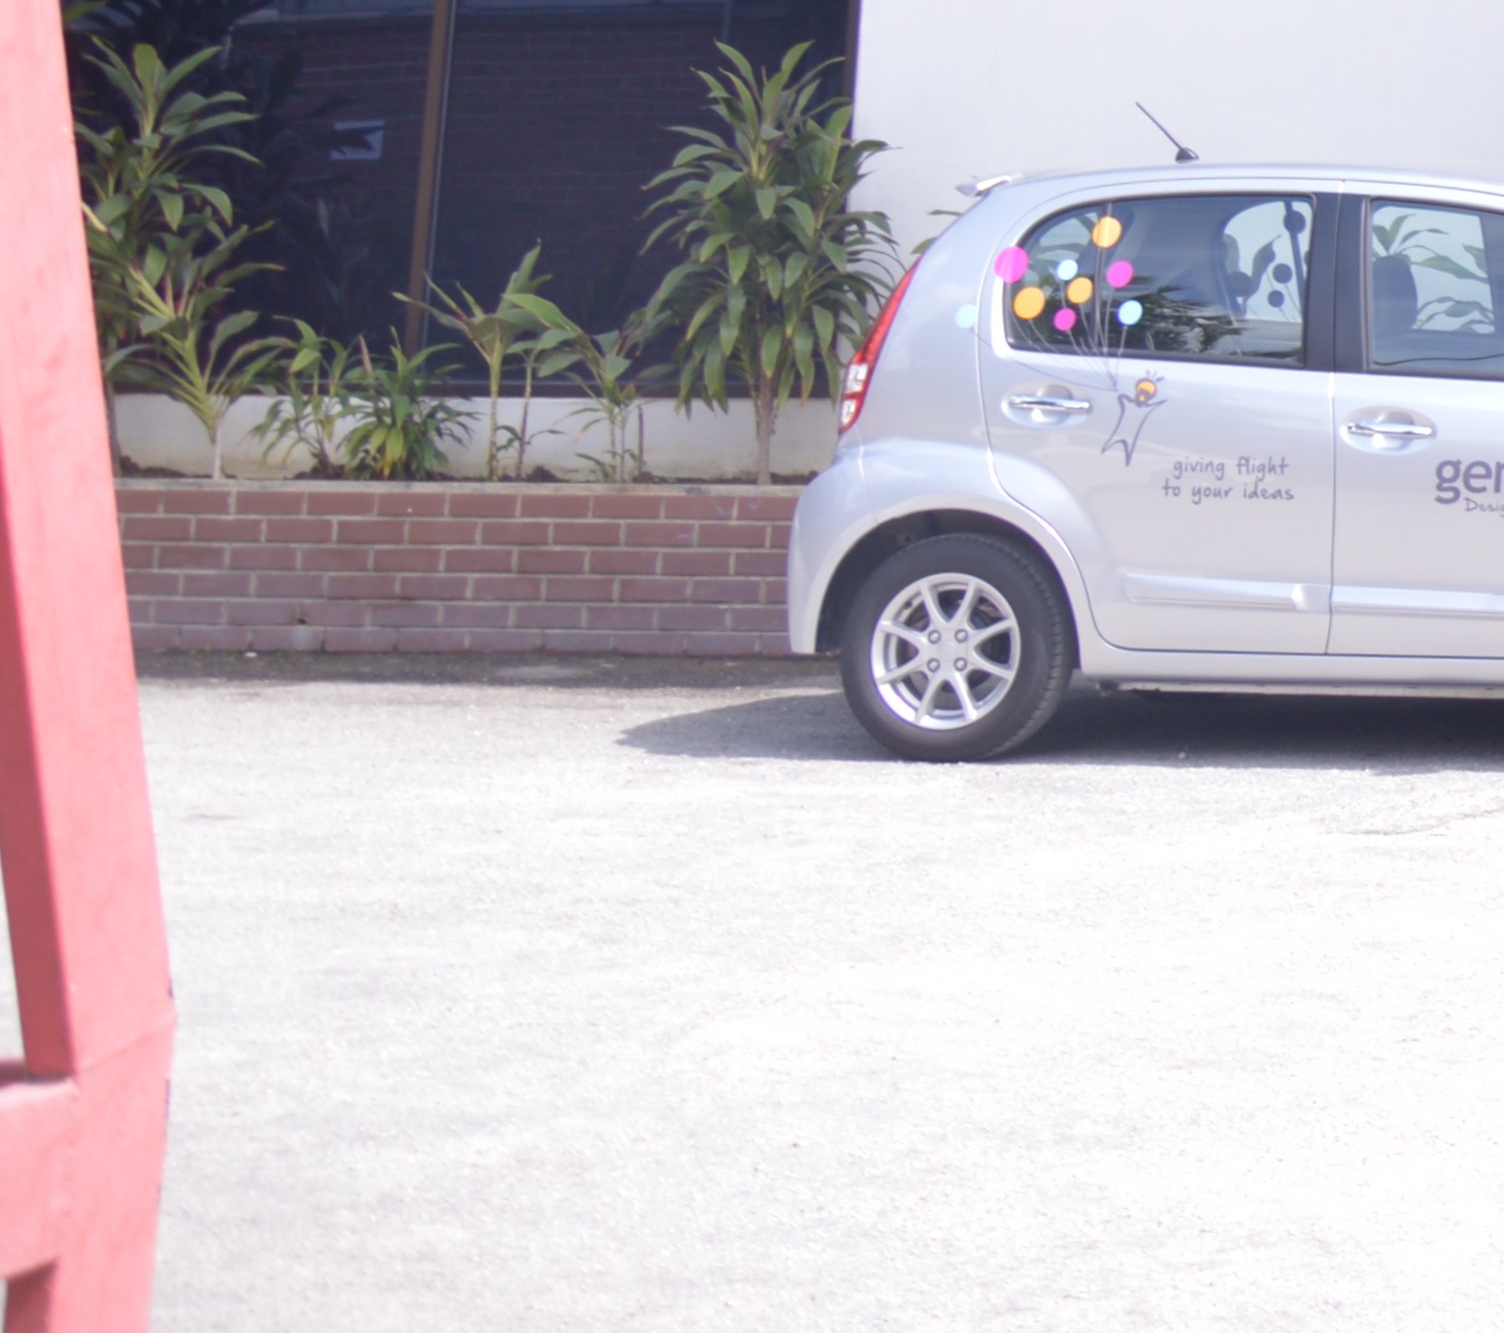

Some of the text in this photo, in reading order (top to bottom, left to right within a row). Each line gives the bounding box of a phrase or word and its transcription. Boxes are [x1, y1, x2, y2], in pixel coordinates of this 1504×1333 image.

[1172, 455, 1290, 482] giving flight
[1161, 478, 1295, 505] to your ideas
